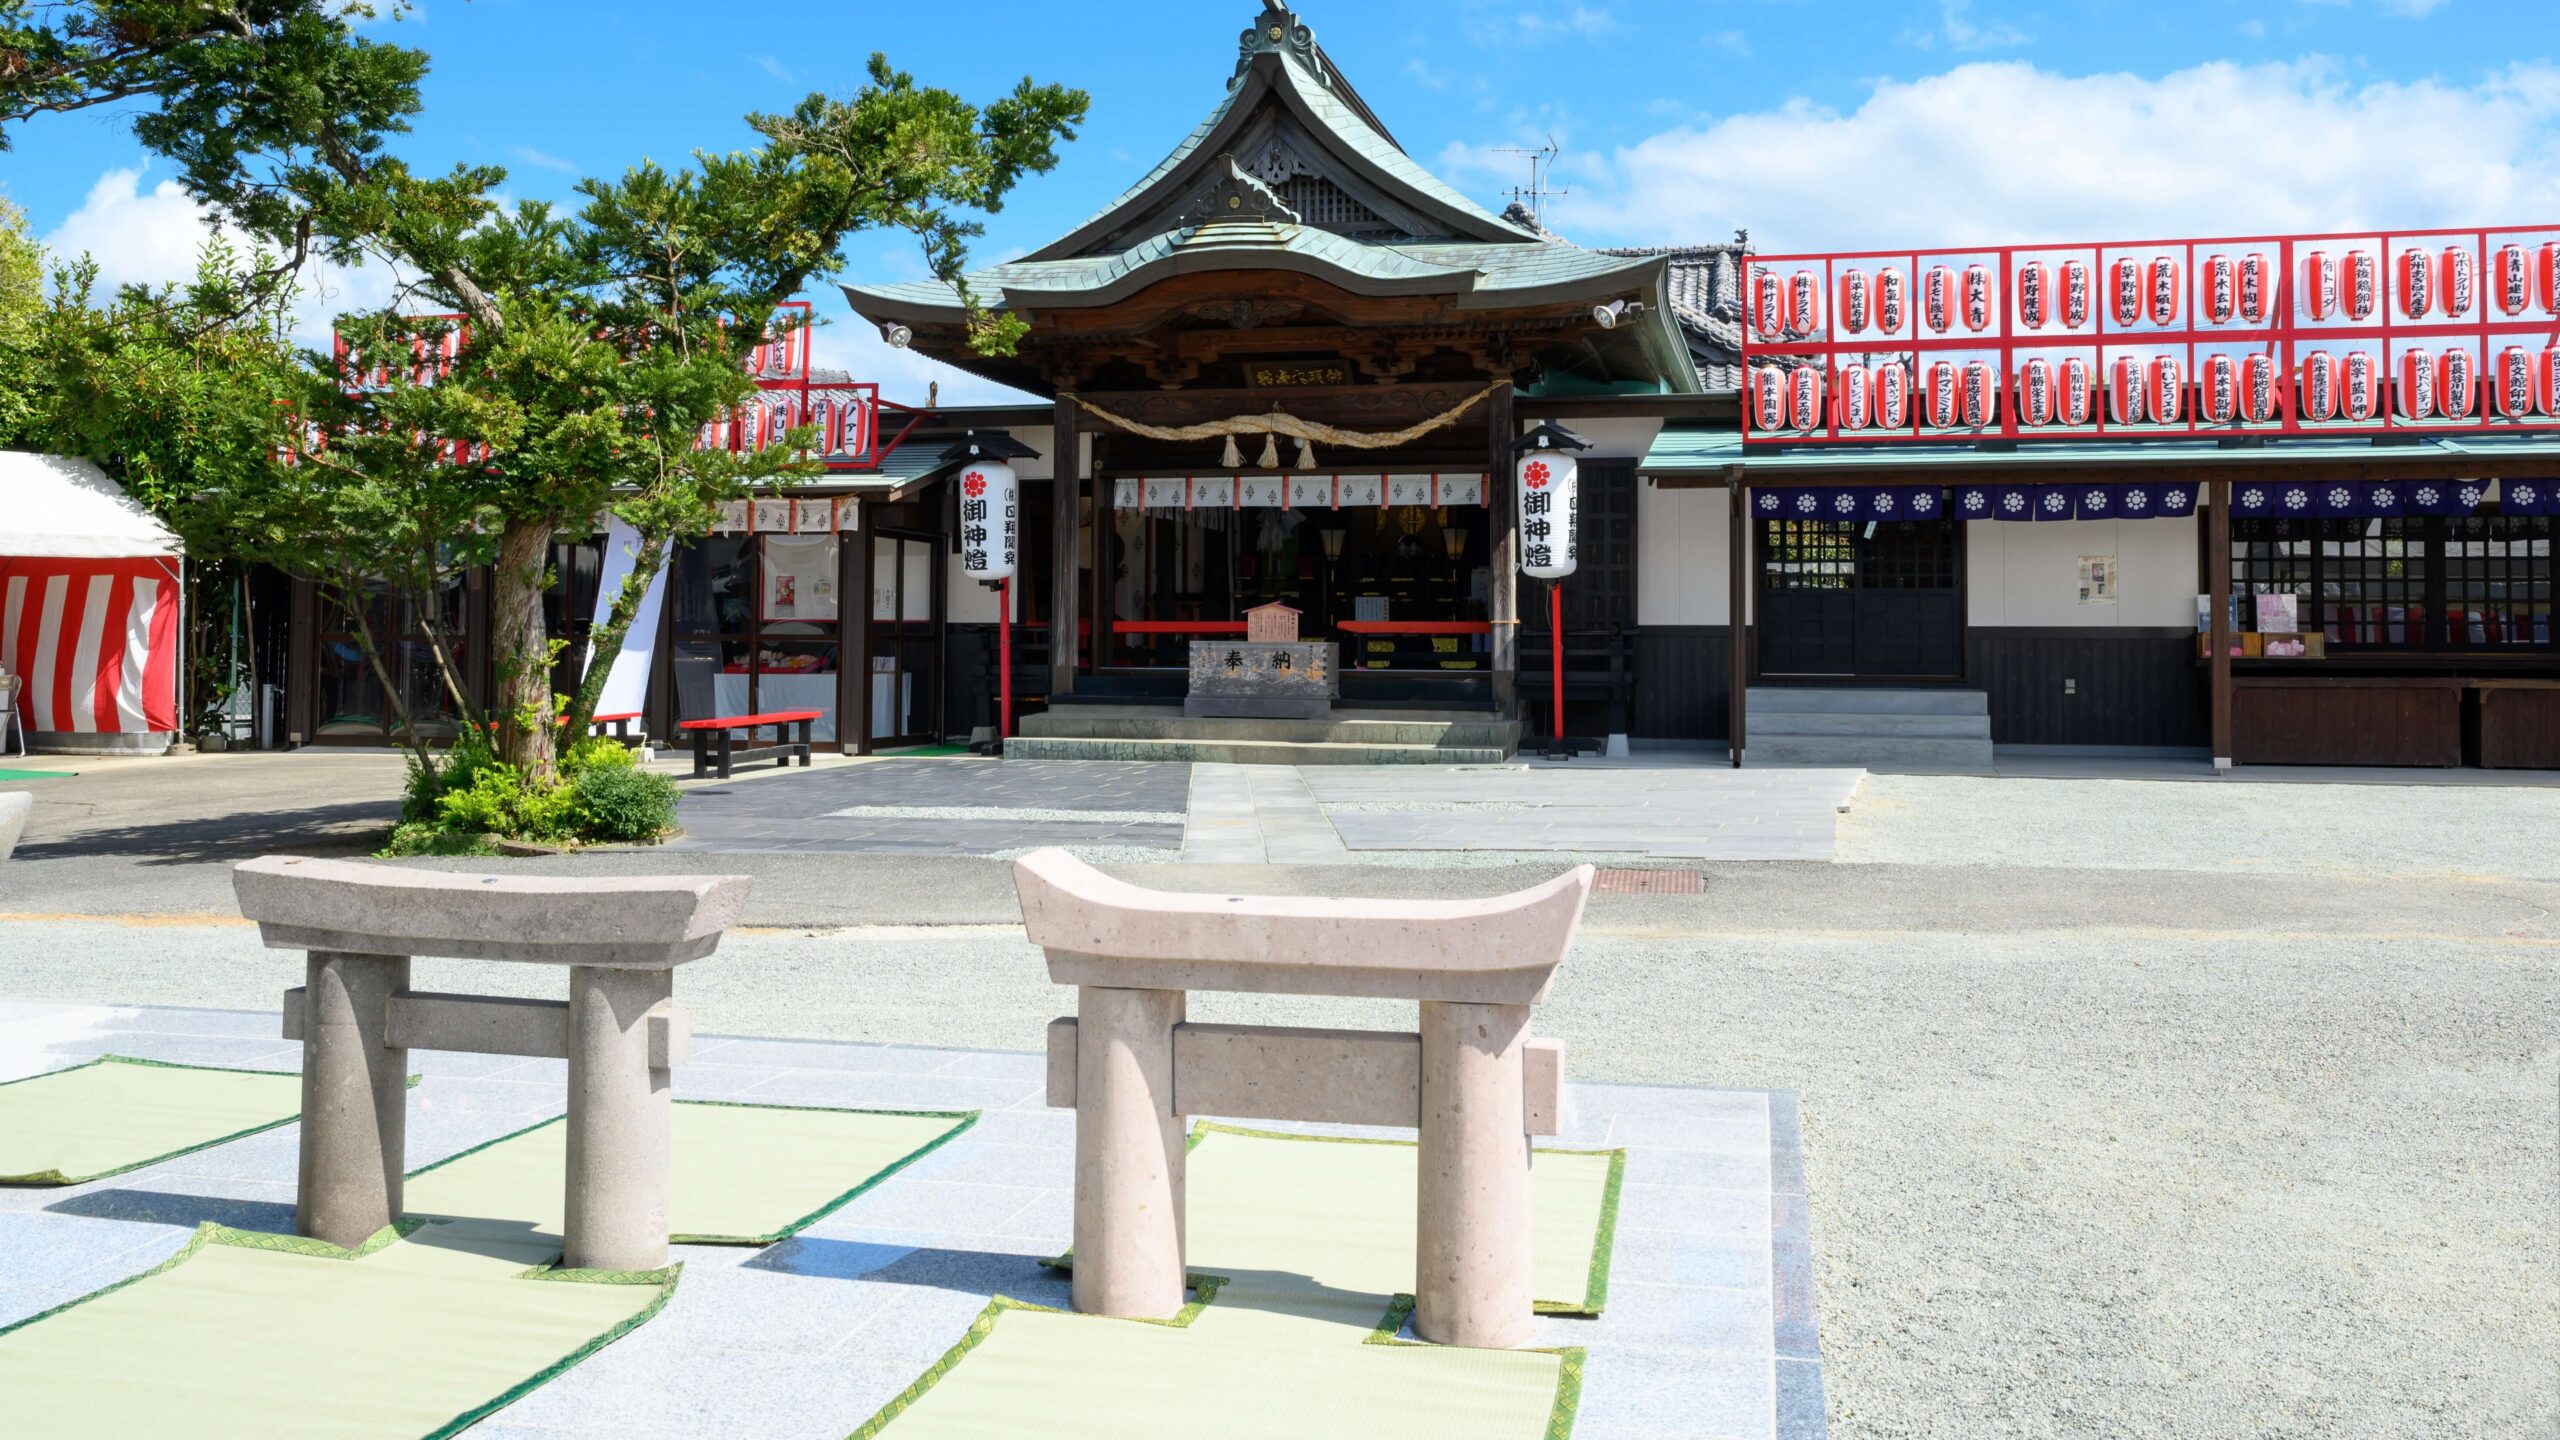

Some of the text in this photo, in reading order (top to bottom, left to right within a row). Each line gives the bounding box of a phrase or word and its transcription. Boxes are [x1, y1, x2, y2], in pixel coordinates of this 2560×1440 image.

[2024, 269, 2039, 322] 草野隆成
[2069, 268, 2085, 321] 草野清成
[2120, 265, 2136, 319] 草野勝成
[1763, 373, 1778, 424] 熊本陶器
[963, 499, 988, 571] 御神燈
[1523, 491, 1552, 567] 御神燈
[1224, 649, 1291, 671] 奉納
